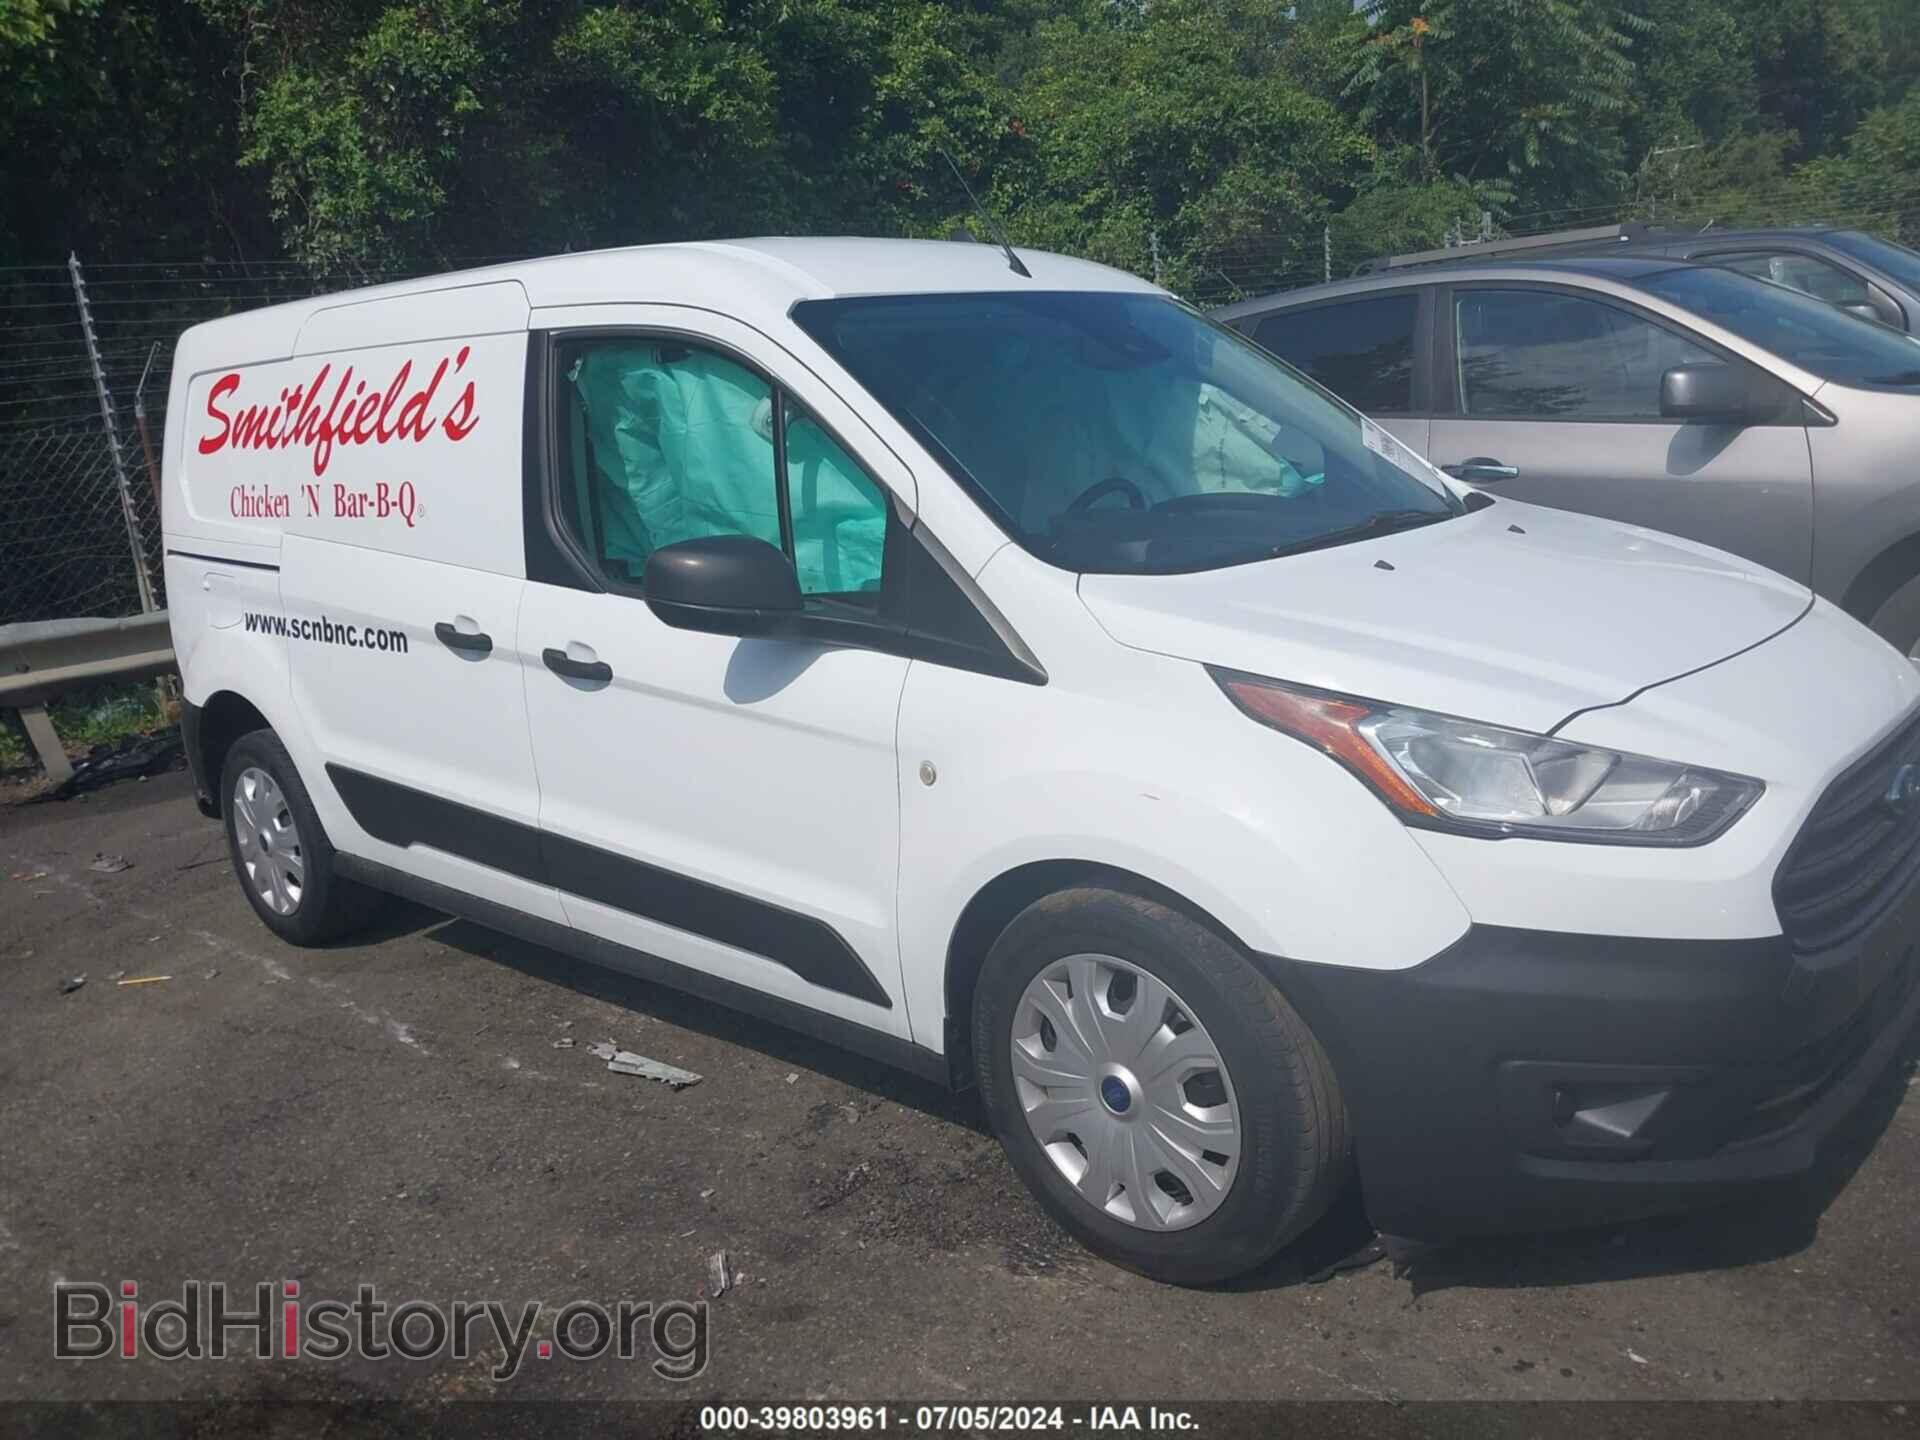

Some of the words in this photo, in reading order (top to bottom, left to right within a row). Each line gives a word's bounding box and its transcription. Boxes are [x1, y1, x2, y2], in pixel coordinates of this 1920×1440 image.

[198, 345, 479, 476] Smithfield's
[230, 484, 290, 518] Chicken
[301, 484, 320, 517] 'N
[334, 481, 415, 527] Bar-B-Q
[245, 611, 409, 653] www.scnbnc.com
